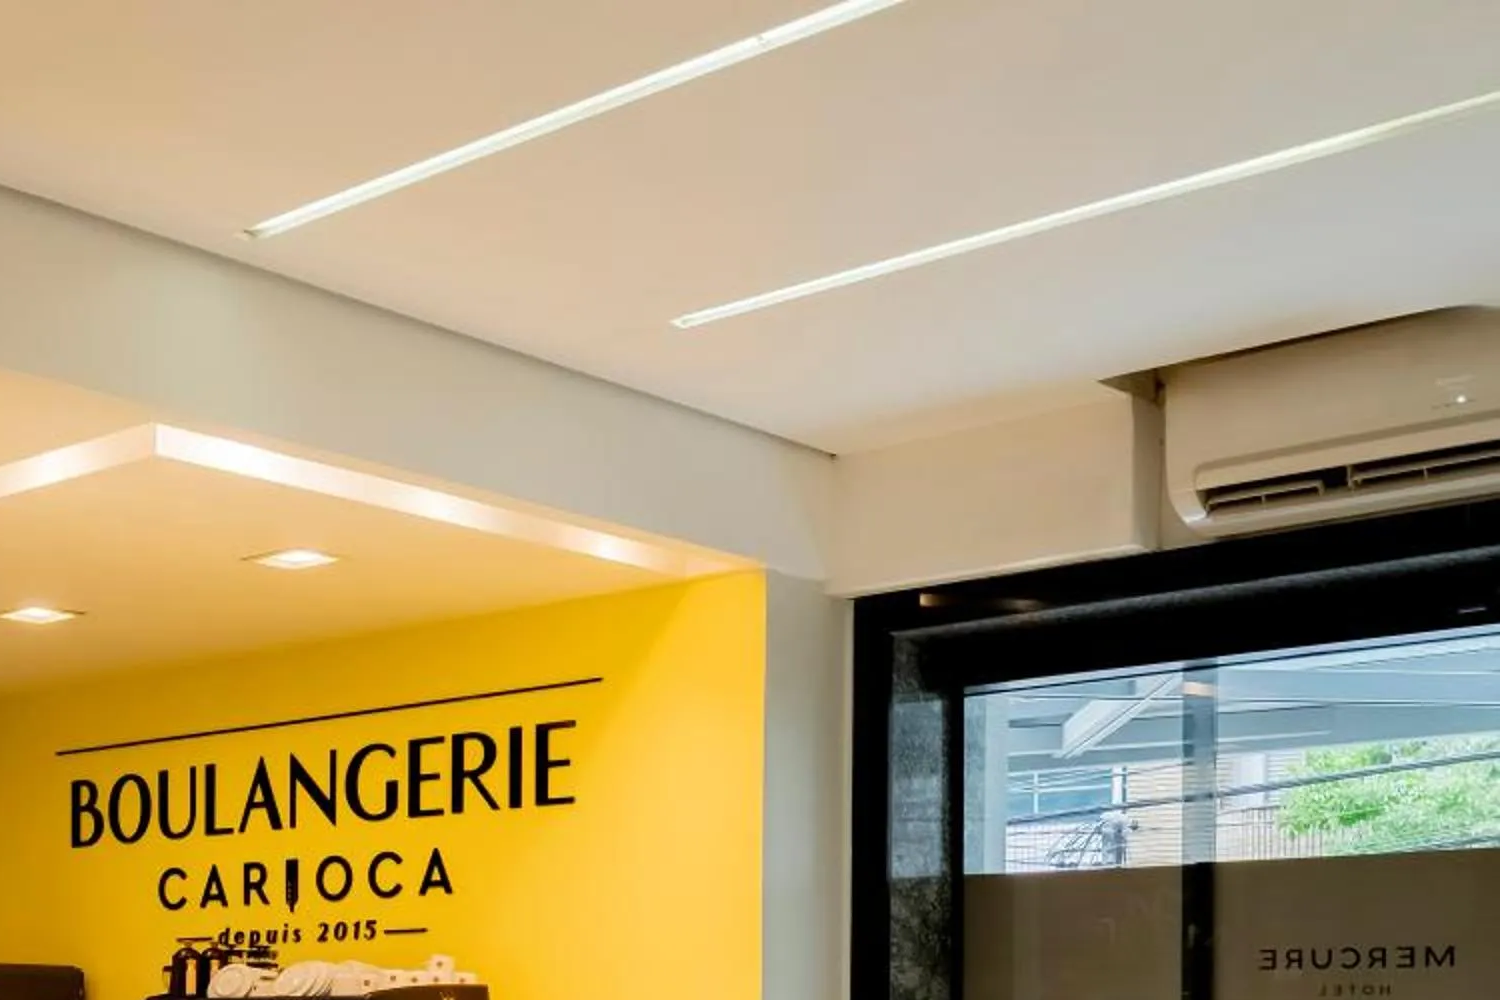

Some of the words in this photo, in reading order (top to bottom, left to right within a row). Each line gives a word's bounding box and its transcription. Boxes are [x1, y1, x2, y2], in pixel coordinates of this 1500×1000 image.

[71, 720, 576, 848] BOULANGERIE
[159, 848, 452, 911] CARIOCA
[218, 923, 301, 946] depuis
[317, 919, 377, 943] 2015
